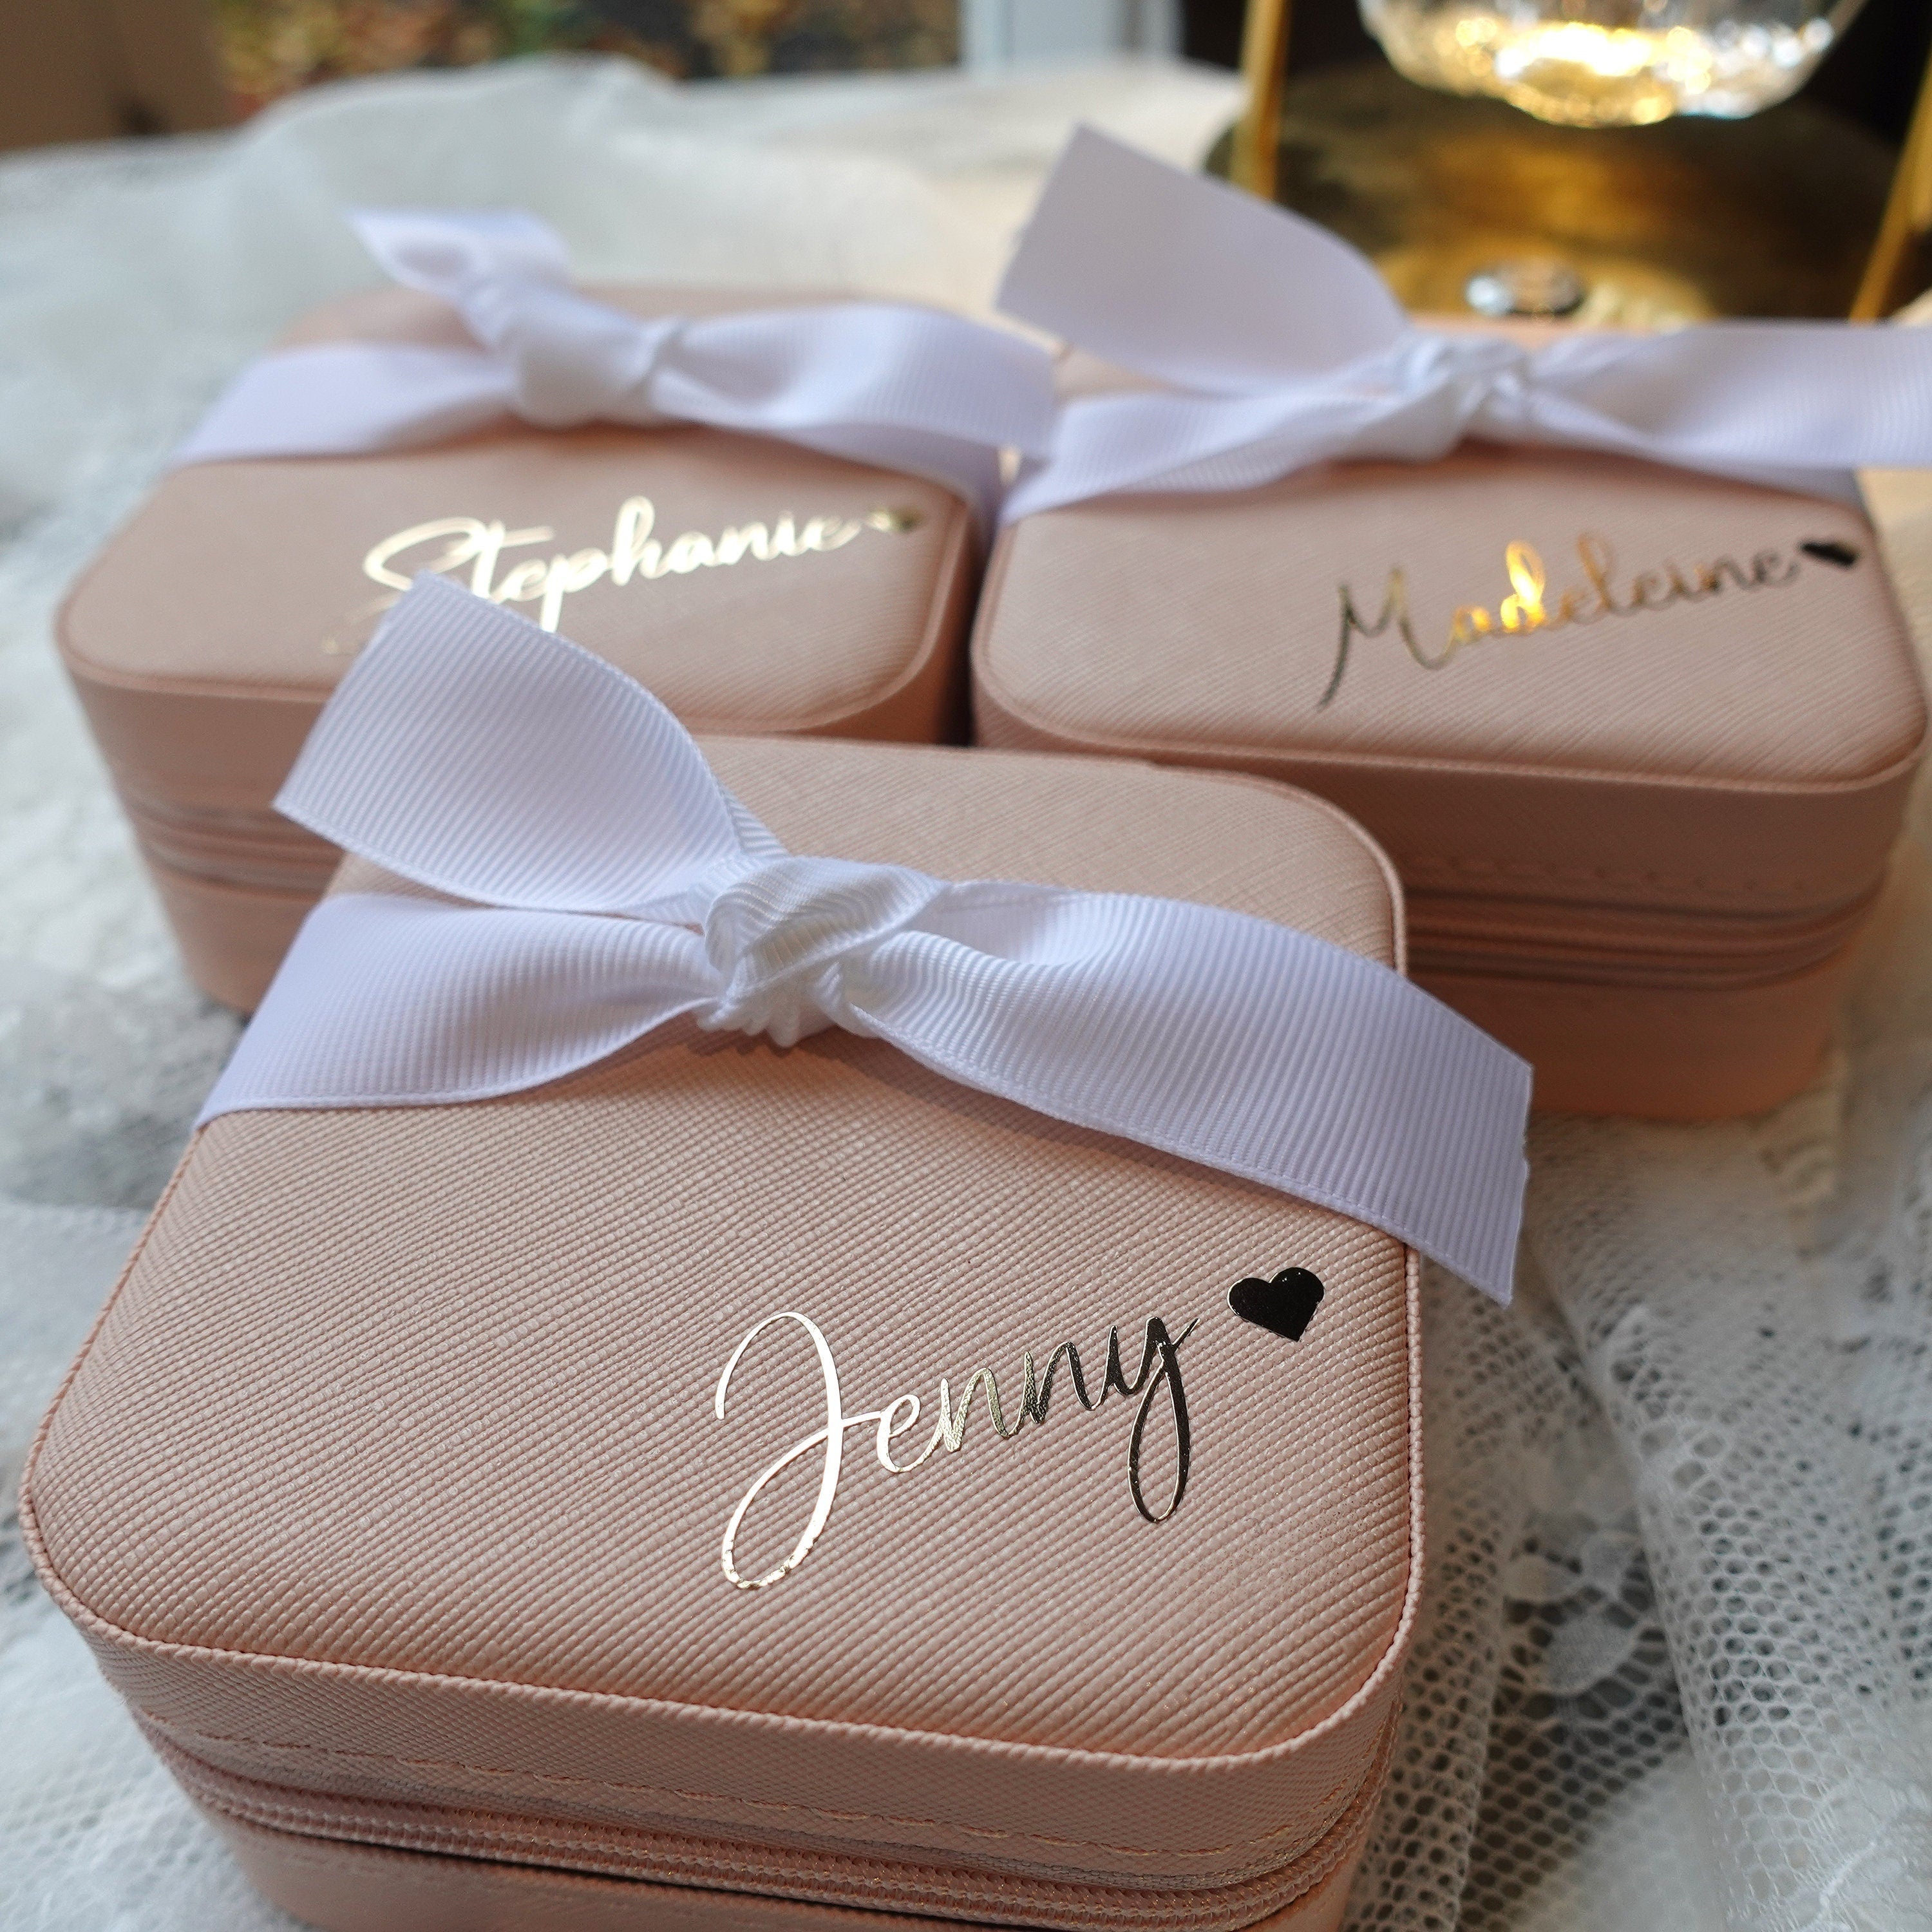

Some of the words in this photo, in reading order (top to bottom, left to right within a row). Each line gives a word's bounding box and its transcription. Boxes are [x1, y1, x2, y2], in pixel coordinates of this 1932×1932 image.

[322, 495, 862, 650] Stephanie
[1318, 532, 1801, 712] Madeleine
[714, 1311, 1200, 1588] Jenny
